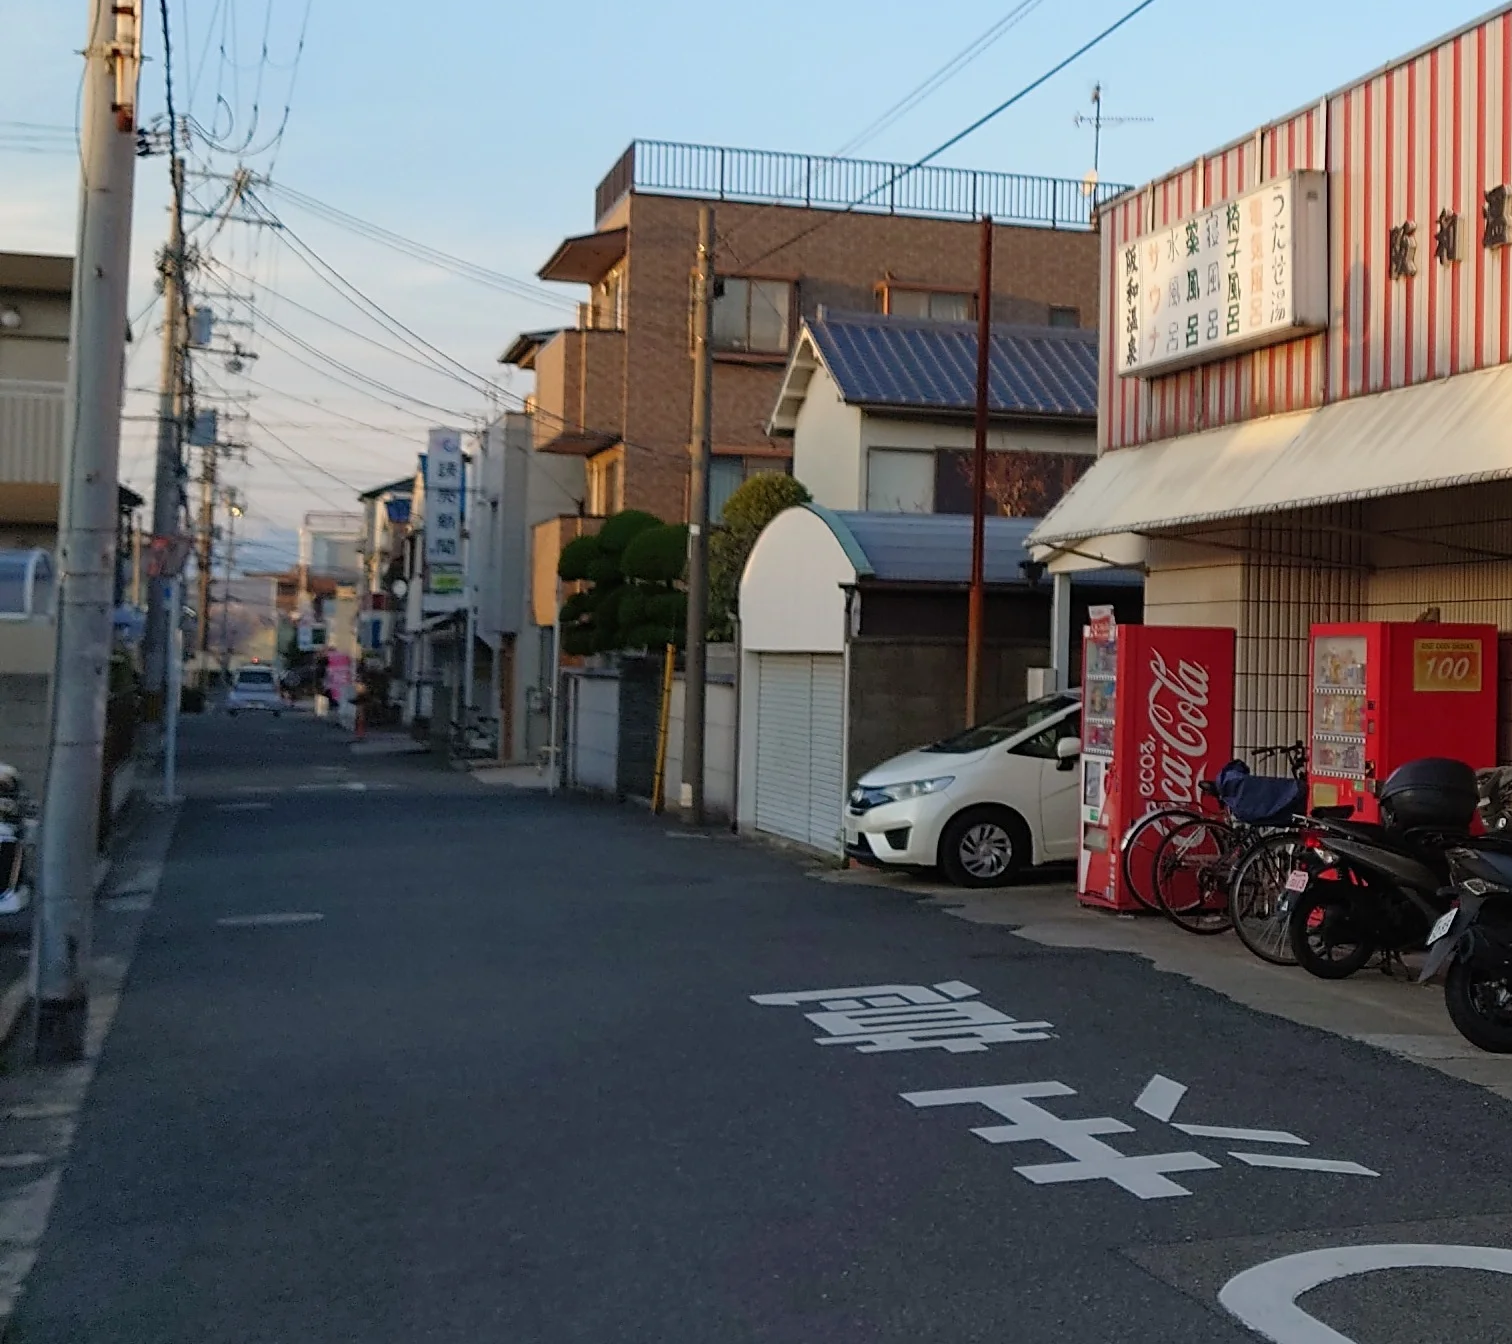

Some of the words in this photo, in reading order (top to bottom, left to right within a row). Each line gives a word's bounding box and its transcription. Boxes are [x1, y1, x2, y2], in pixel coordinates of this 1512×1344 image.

[1125, 244, 1141, 366] 阪和温泉
[1147, 242, 1162, 356] サウナ
[1166, 229, 1181, 353] 水風呂
[1185, 219, 1200, 349] 薬風呂
[1226, 203, 1241, 337] 椅子風呂
[1270, 185, 1287, 323] うたせ湯
[1426, 657, 1470, 681] 100
